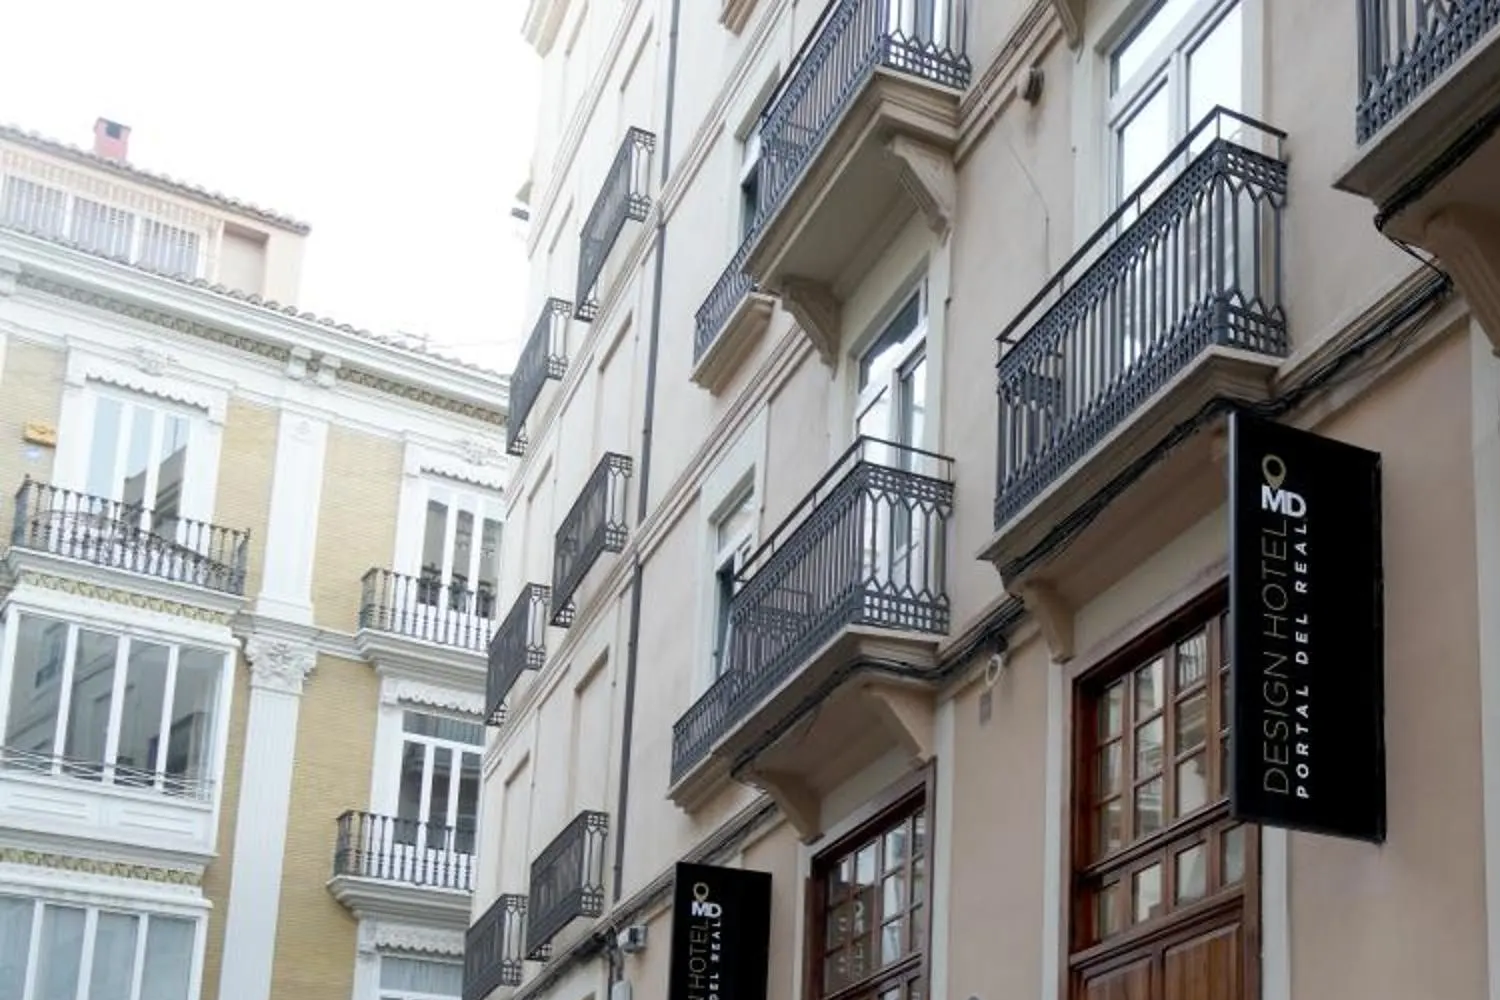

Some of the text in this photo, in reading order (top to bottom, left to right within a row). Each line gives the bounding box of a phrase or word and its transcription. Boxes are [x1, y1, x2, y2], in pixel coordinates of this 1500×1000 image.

[1261, 485, 1307, 518] MD
[1261, 519, 1290, 795] DESIGN HOTEL
[1294, 522, 1310, 799] PORTAL DEL REAL
[691, 901, 722, 918] MD
[688, 917, 709, 989] HOTEL
[710, 919, 721, 963] REAL
